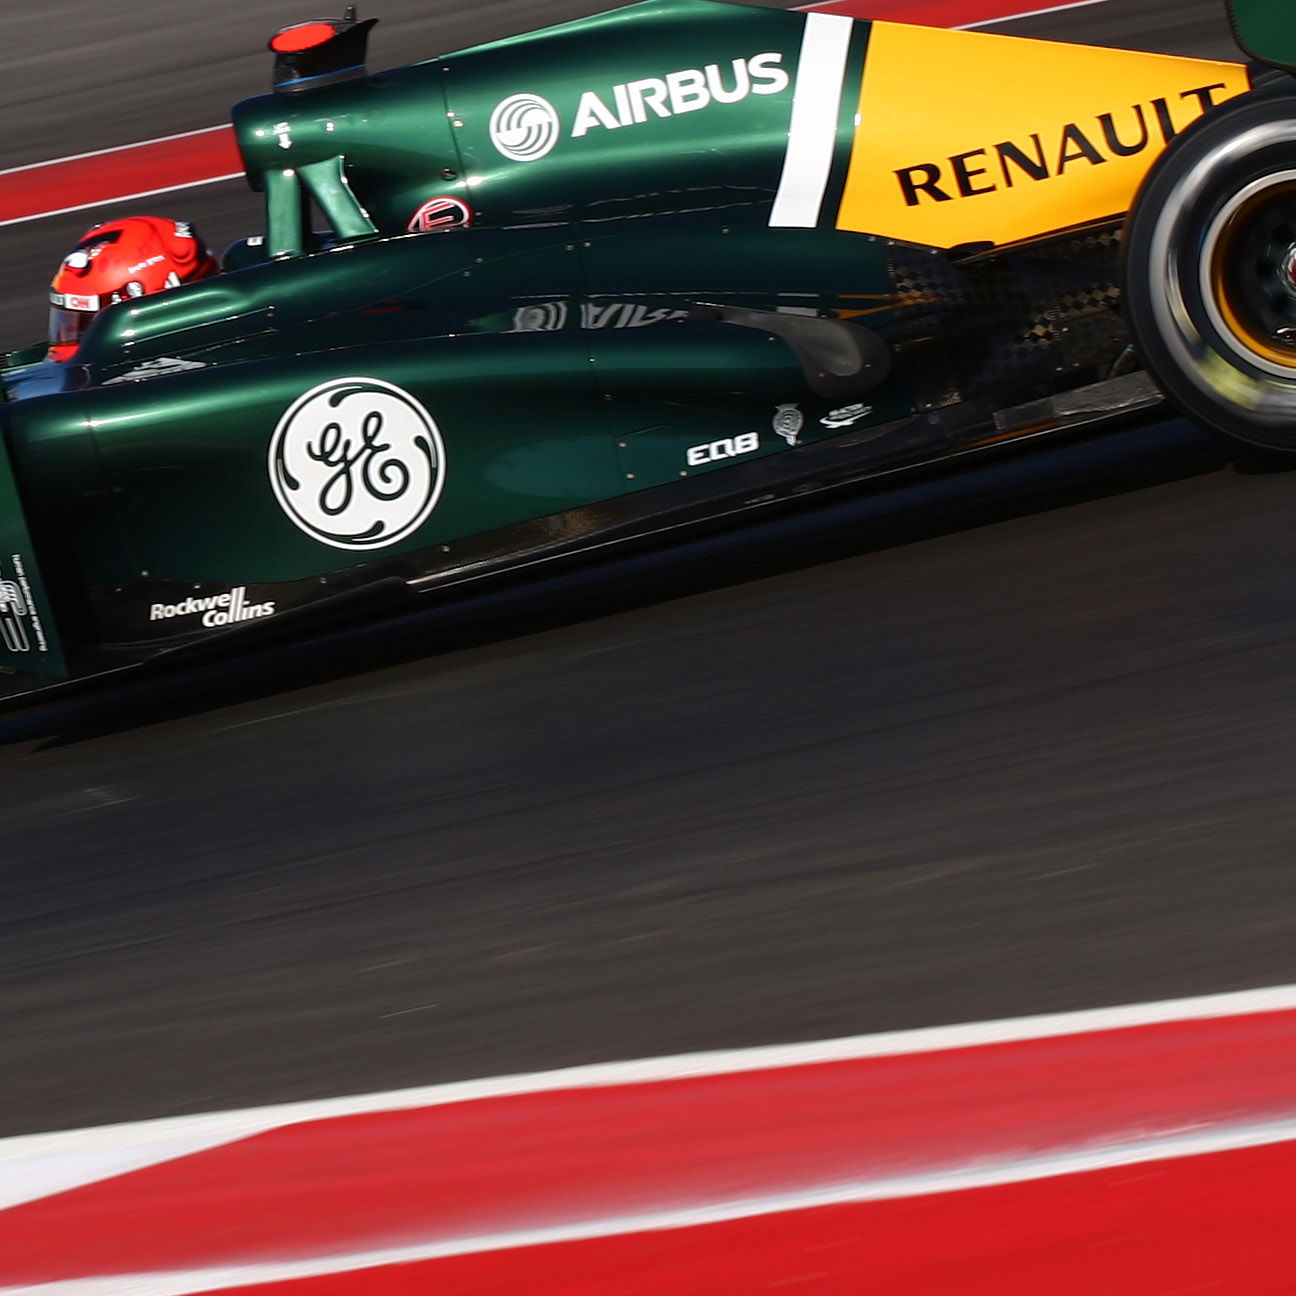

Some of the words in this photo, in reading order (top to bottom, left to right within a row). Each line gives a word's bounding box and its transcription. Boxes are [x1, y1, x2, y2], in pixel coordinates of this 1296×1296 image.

[571, 52, 789, 137] AIRBUS
[892, 82, 1226, 206] RENAULT
[150, 586, 245, 621] Rockwell
[202, 586, 276, 627] Collins
